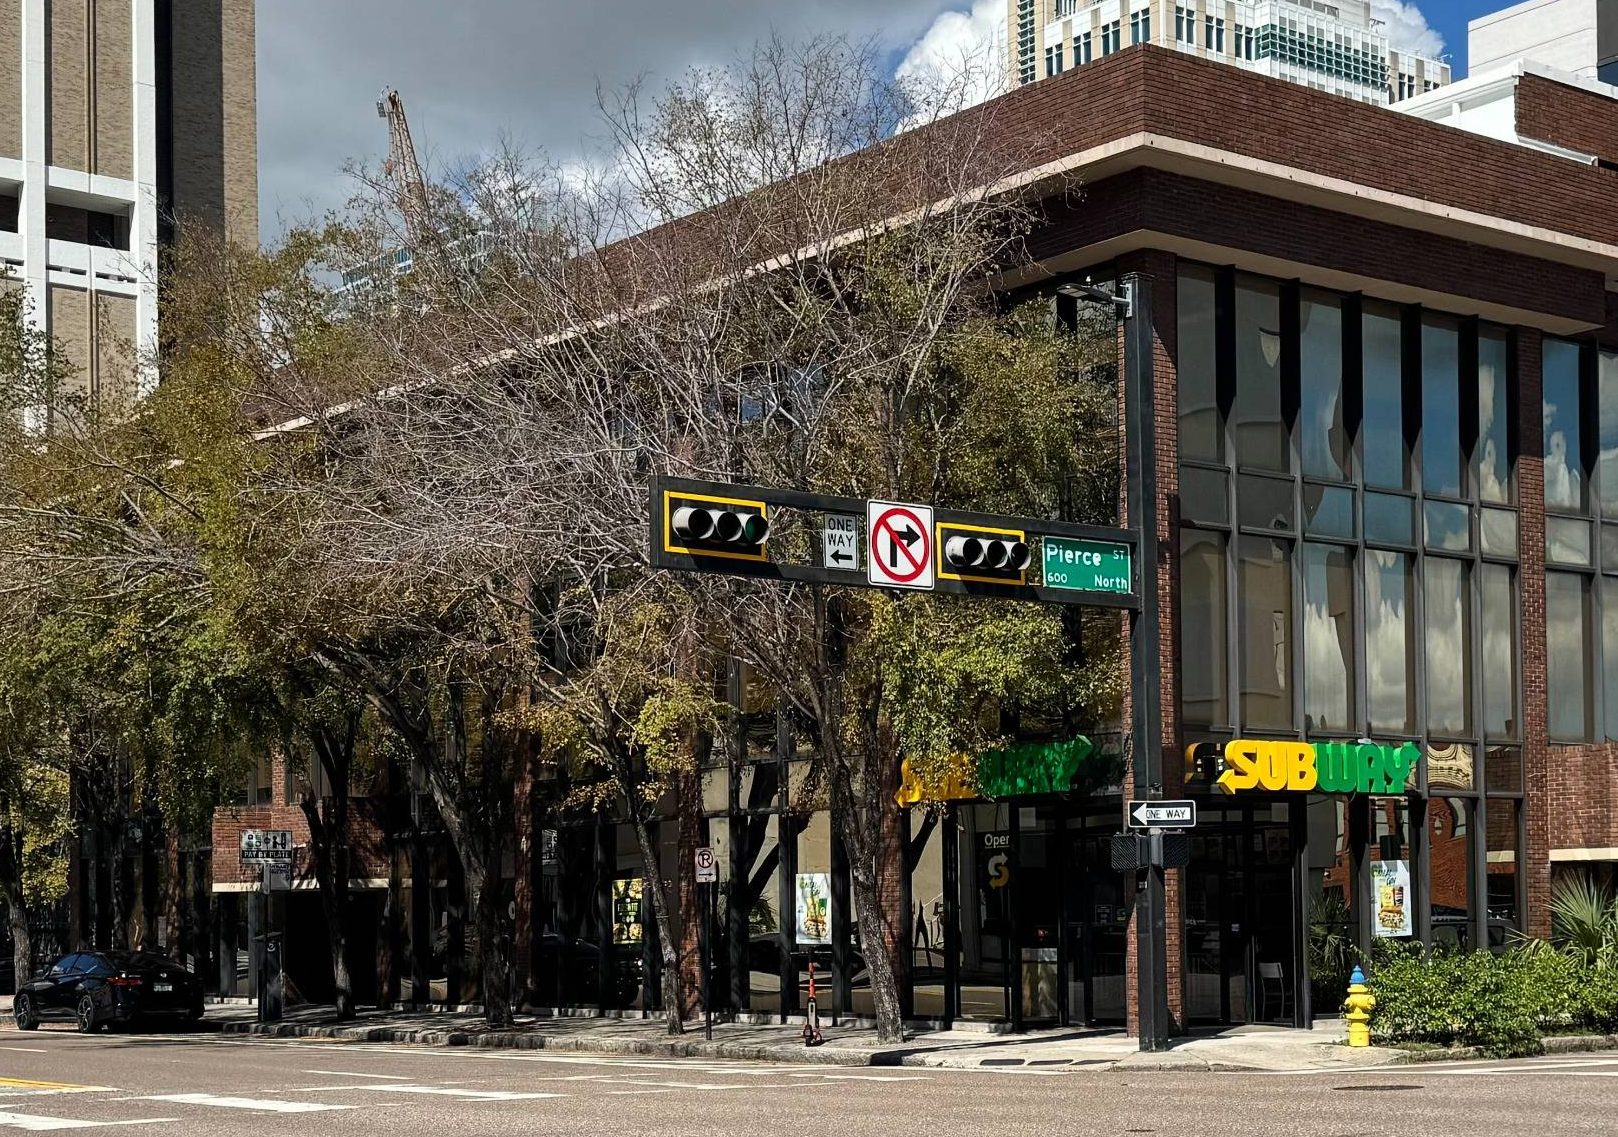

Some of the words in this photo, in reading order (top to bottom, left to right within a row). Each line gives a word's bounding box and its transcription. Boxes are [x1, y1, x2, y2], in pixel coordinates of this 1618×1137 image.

[828, 517, 853, 532] ONE
[827, 533, 854, 547] WAY
[1046, 543, 1102, 567] Pierce
[1112, 550, 1125, 560] ST
[1047, 572, 1068, 583] 600
[1094, 574, 1128, 590] North
[1216, 740, 1422, 795] SUBWAY
[1145, 809, 1161, 819] ONE
[1166, 809, 1186, 819] WAY
